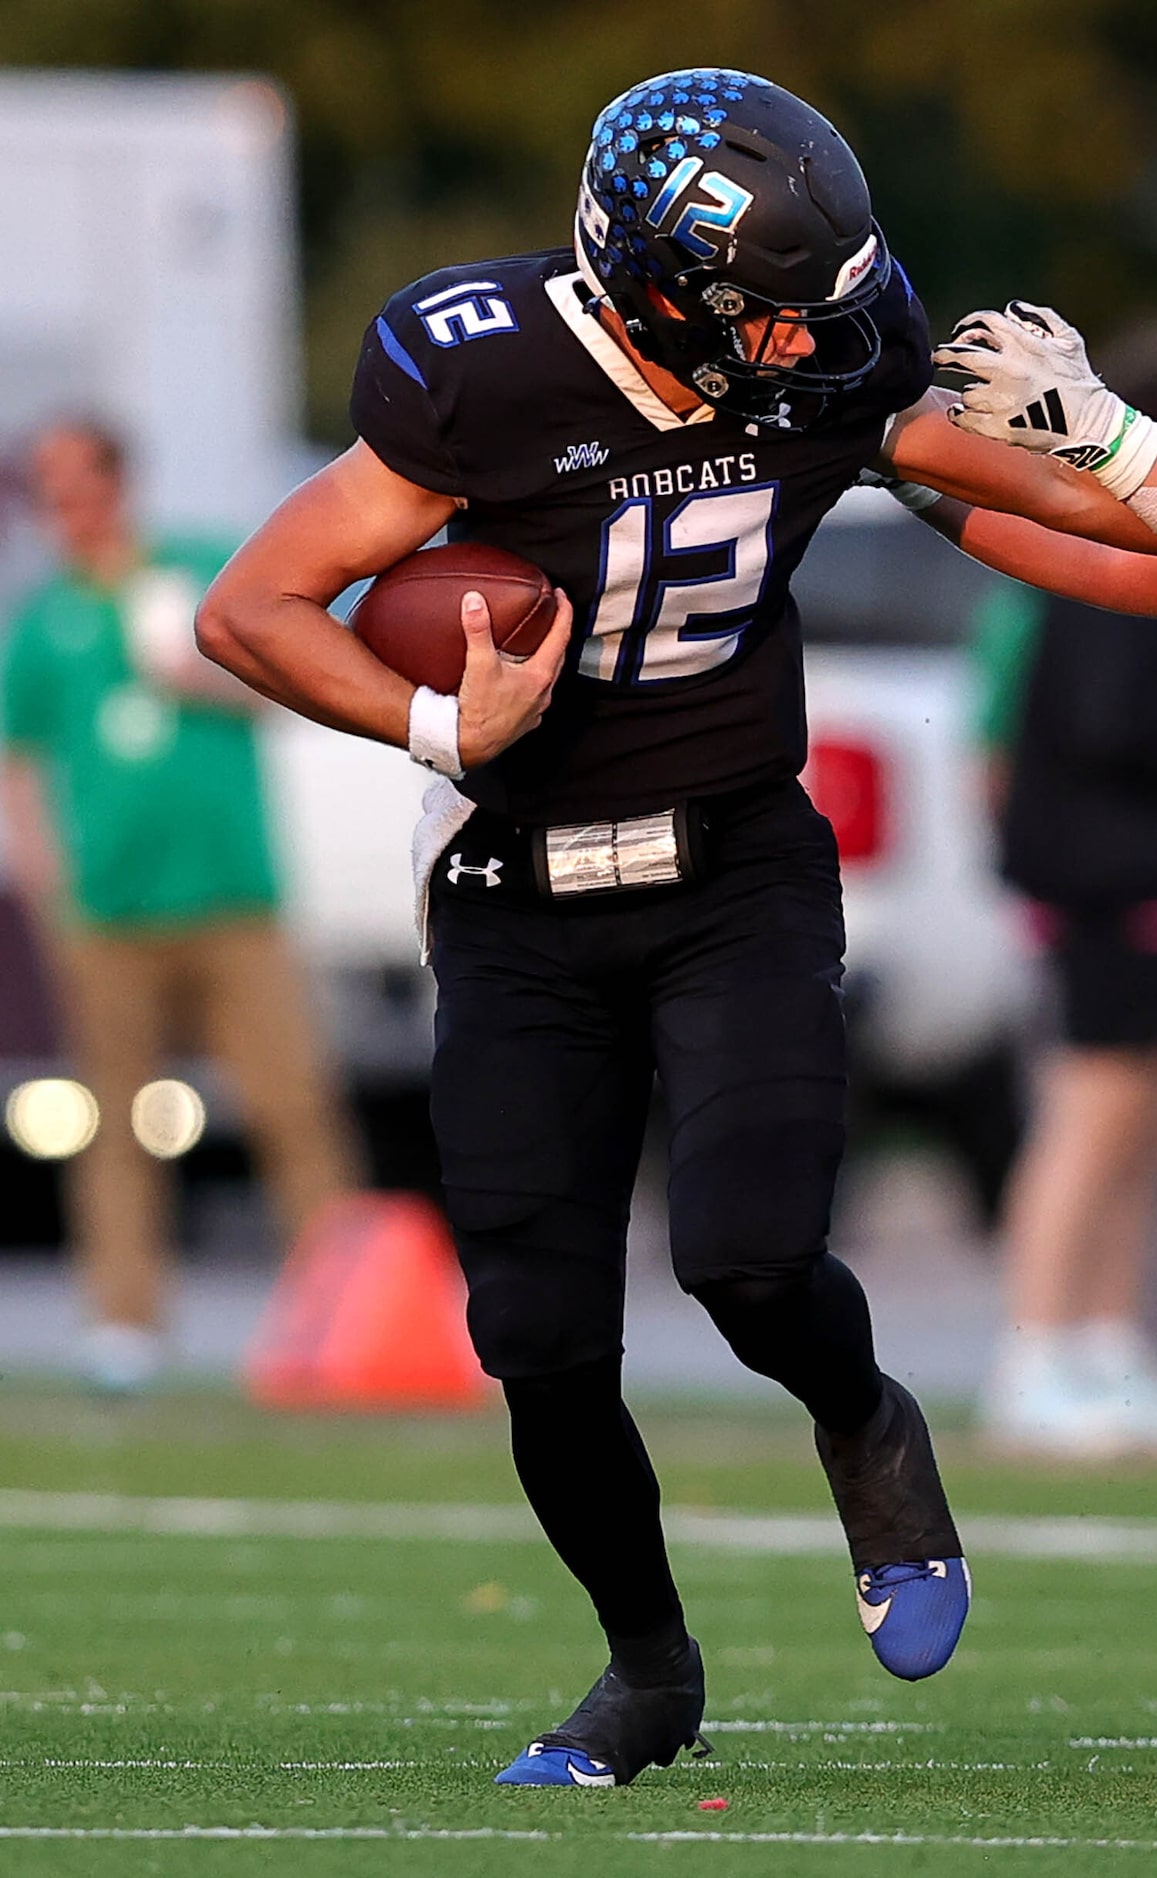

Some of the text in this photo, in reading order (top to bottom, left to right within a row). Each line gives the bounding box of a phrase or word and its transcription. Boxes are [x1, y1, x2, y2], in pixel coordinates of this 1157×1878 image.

[646, 155, 754, 259] 12
[413, 280, 519, 348] 12
[609, 453, 757, 500] BOBCATS
[578, 480, 779, 686] 12
